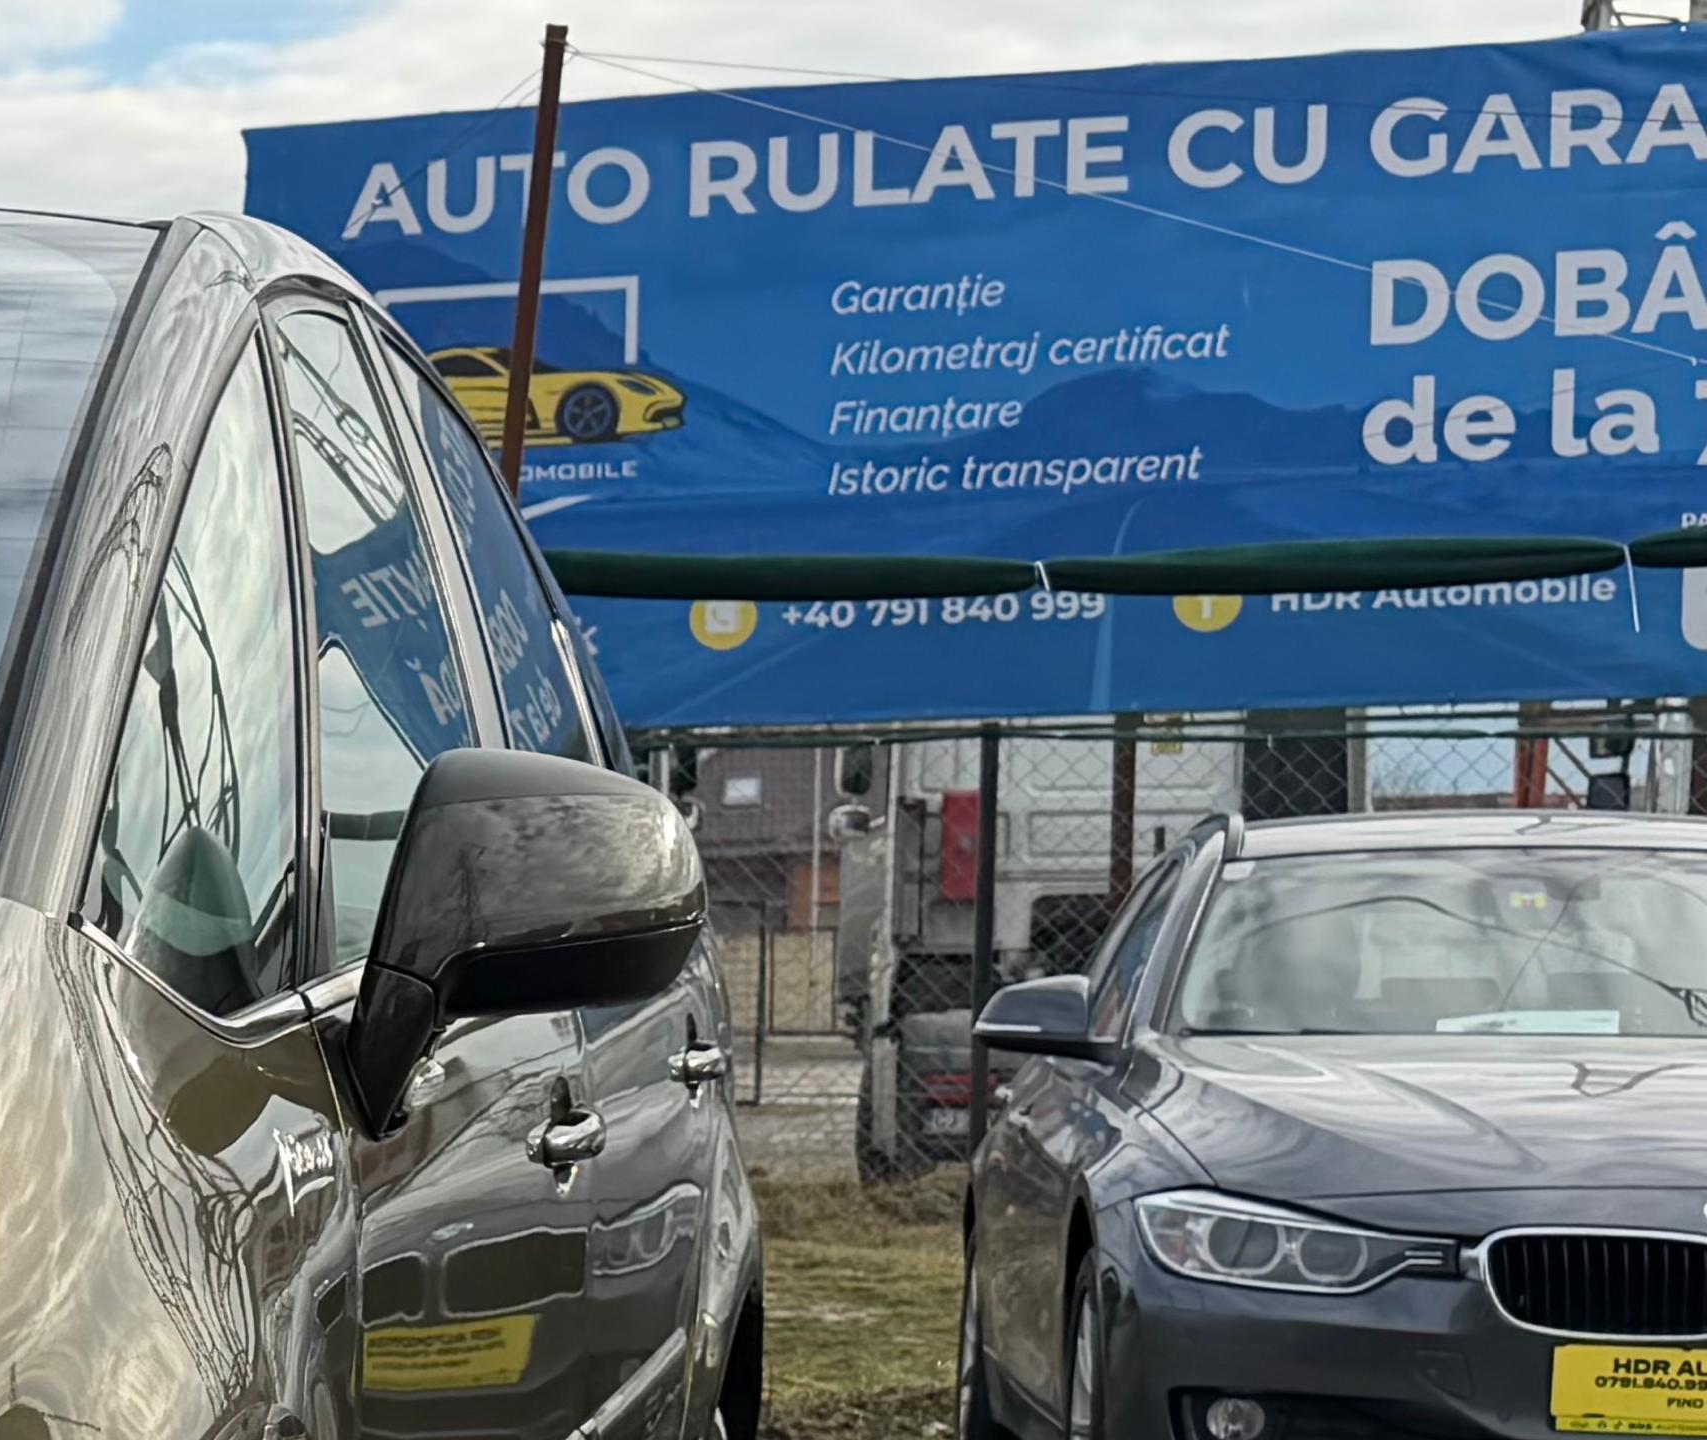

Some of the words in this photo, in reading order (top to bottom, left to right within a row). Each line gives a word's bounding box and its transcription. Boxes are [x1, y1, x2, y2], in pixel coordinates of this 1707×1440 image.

[342, 146, 650, 240] AUTO
[689, 115, 1128, 218] RULATE
[1168, 104, 1327, 189] CU
[1371, 84, 1707, 178] GARA
[831, 273, 1005, 316] Garanție
[1370, 221, 1707, 346] DOBÂ
[830, 331, 1041, 376] Kilometraj
[1048, 324, 1231, 366] certificat
[829, 397, 1023, 438] Finanțare
[1363, 374, 1516, 465] de
[1551, 368, 1659, 458] la
[828, 457, 950, 496] Istoric
[962, 446, 1203, 494] transparent
[781, 600, 855, 628] +40
[867, 600, 928, 626] 791
[941, 594, 1019, 624] 840
[1031, 591, 1105, 621] 999
[1613, 1358, 1670, 1375] HDR
